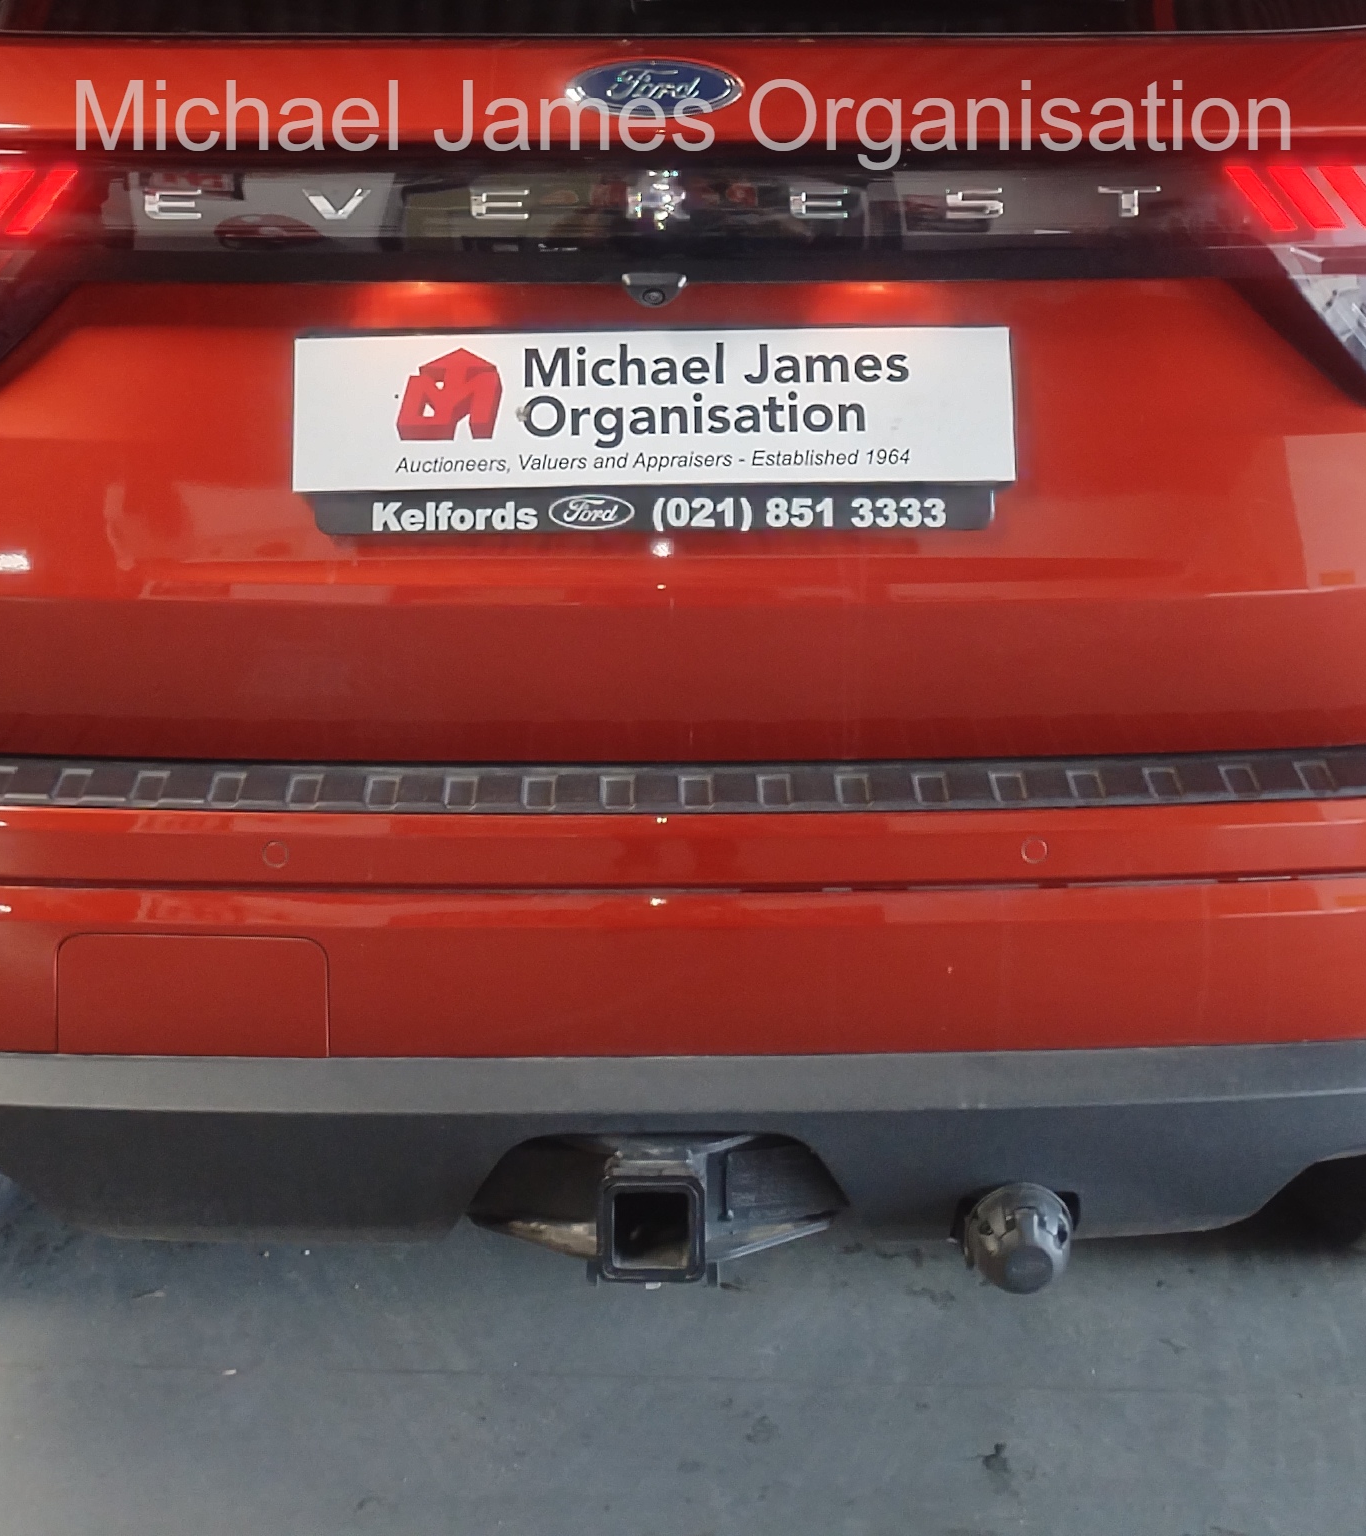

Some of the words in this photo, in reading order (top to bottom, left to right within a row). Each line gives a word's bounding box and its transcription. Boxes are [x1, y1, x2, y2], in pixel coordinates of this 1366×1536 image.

[524, 343, 724, 387] Michael
[744, 344, 909, 385] James
[524, 391, 866, 448] Organisation
[395, 457, 511, 474] Auctioneers,
[519, 454, 587, 471] Valuers
[594, 453, 627, 469] and
[633, 451, 732, 472] Appraisers
[752, 449, 859, 467] Established
[866, 448, 910, 465] 1964
[372, 501, 538, 531] Kelfords
[652, 497, 753, 532] (021)
[766, 497, 834, 527] 851
[850, 497, 946, 528] 3333
